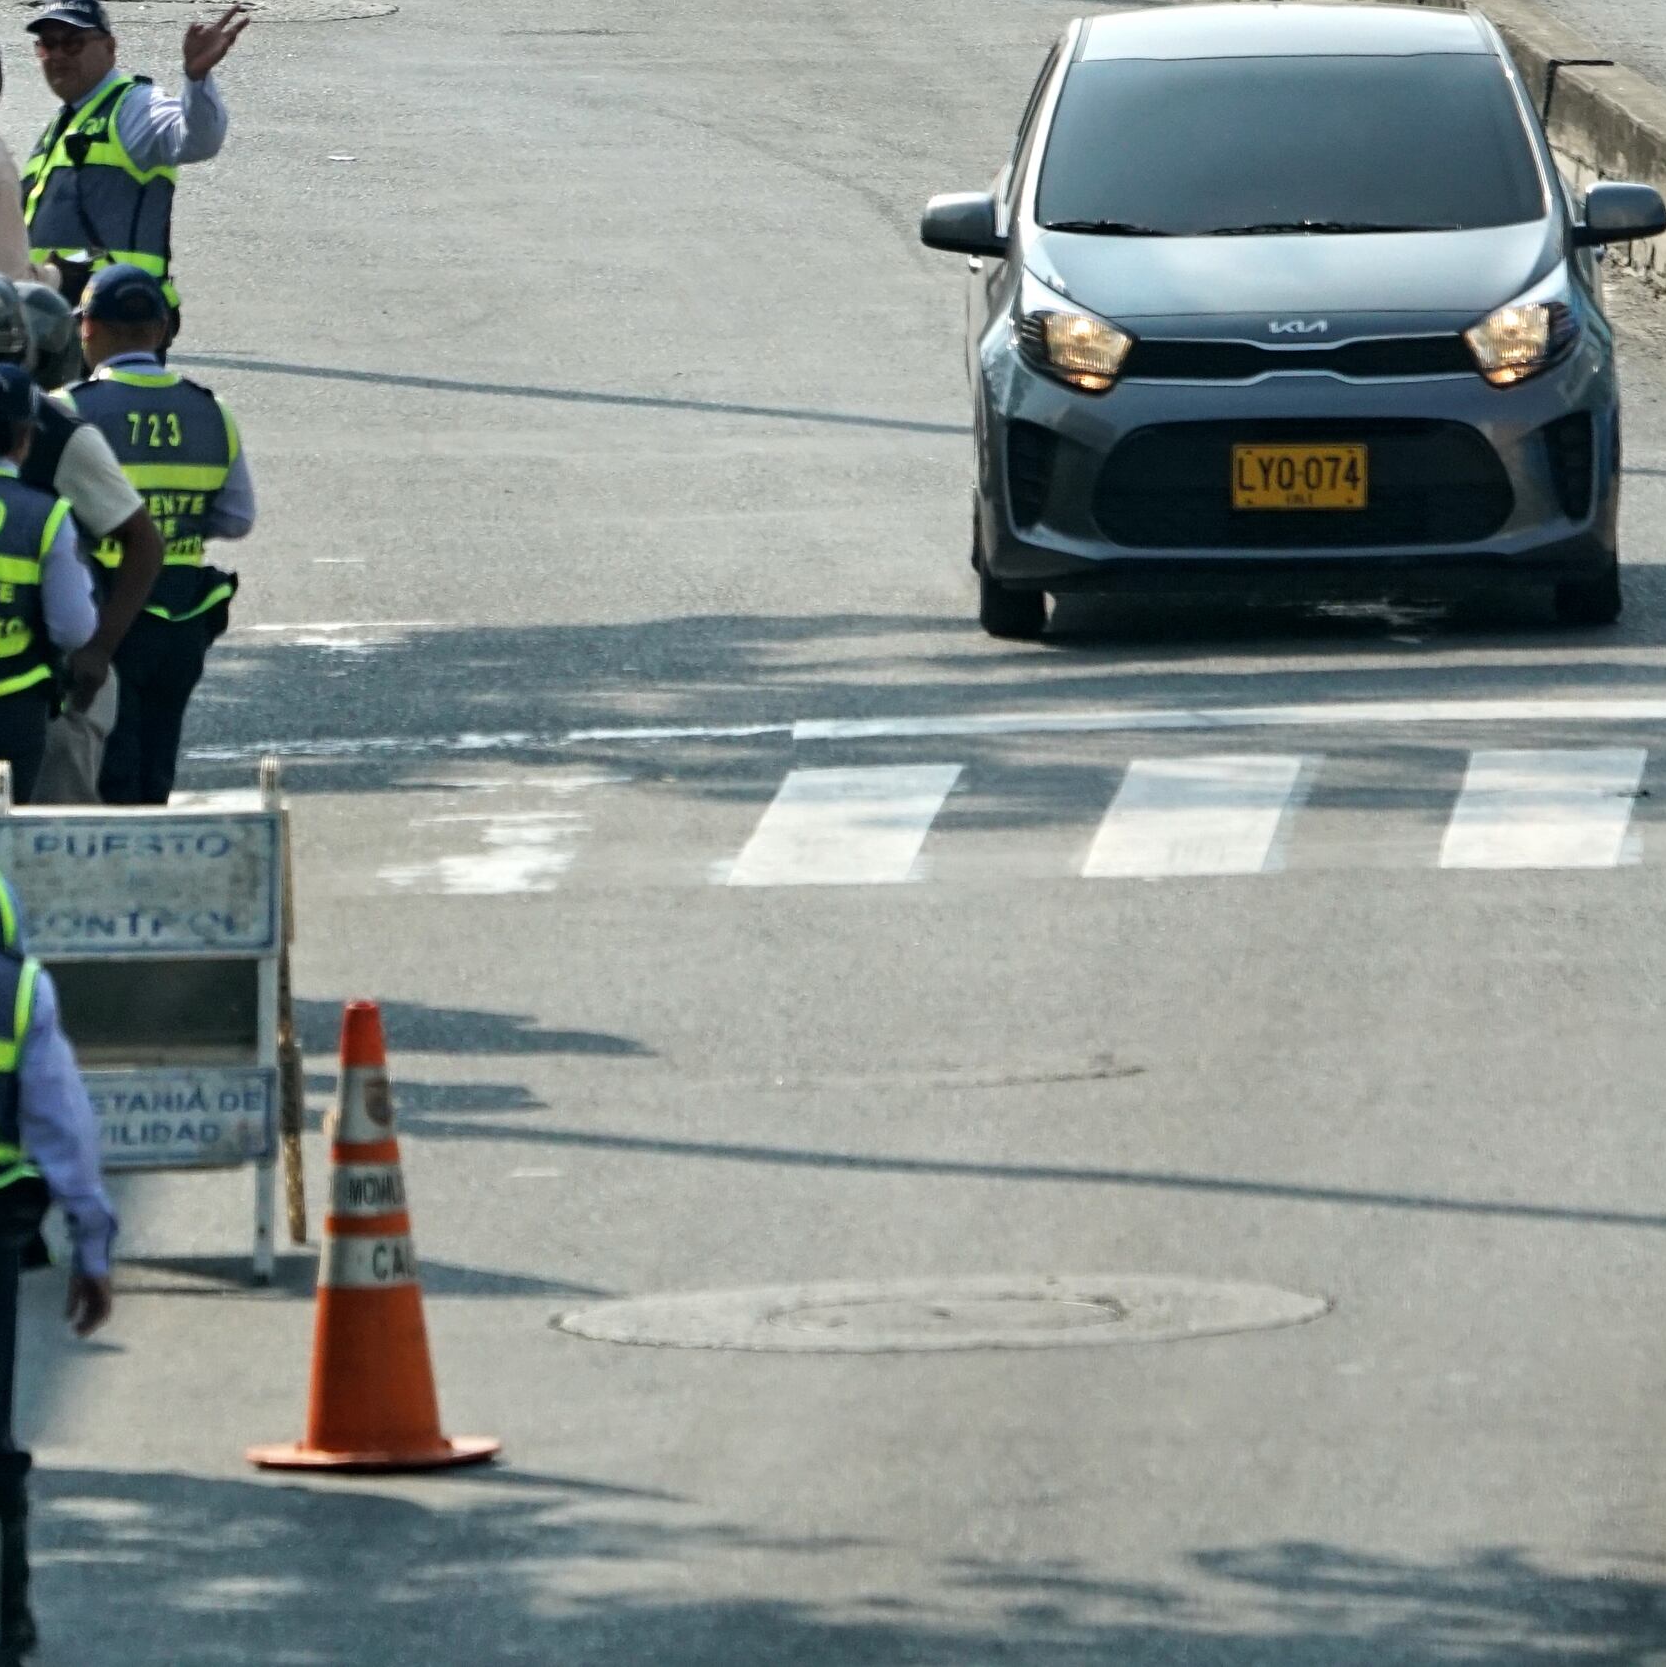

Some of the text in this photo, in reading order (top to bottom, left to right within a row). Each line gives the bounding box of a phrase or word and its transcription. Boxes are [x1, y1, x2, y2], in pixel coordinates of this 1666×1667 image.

[1268, 320, 1328, 334] KIA
[127, 412, 182, 447] 723
[33, 834, 231, 859] PUESTO
